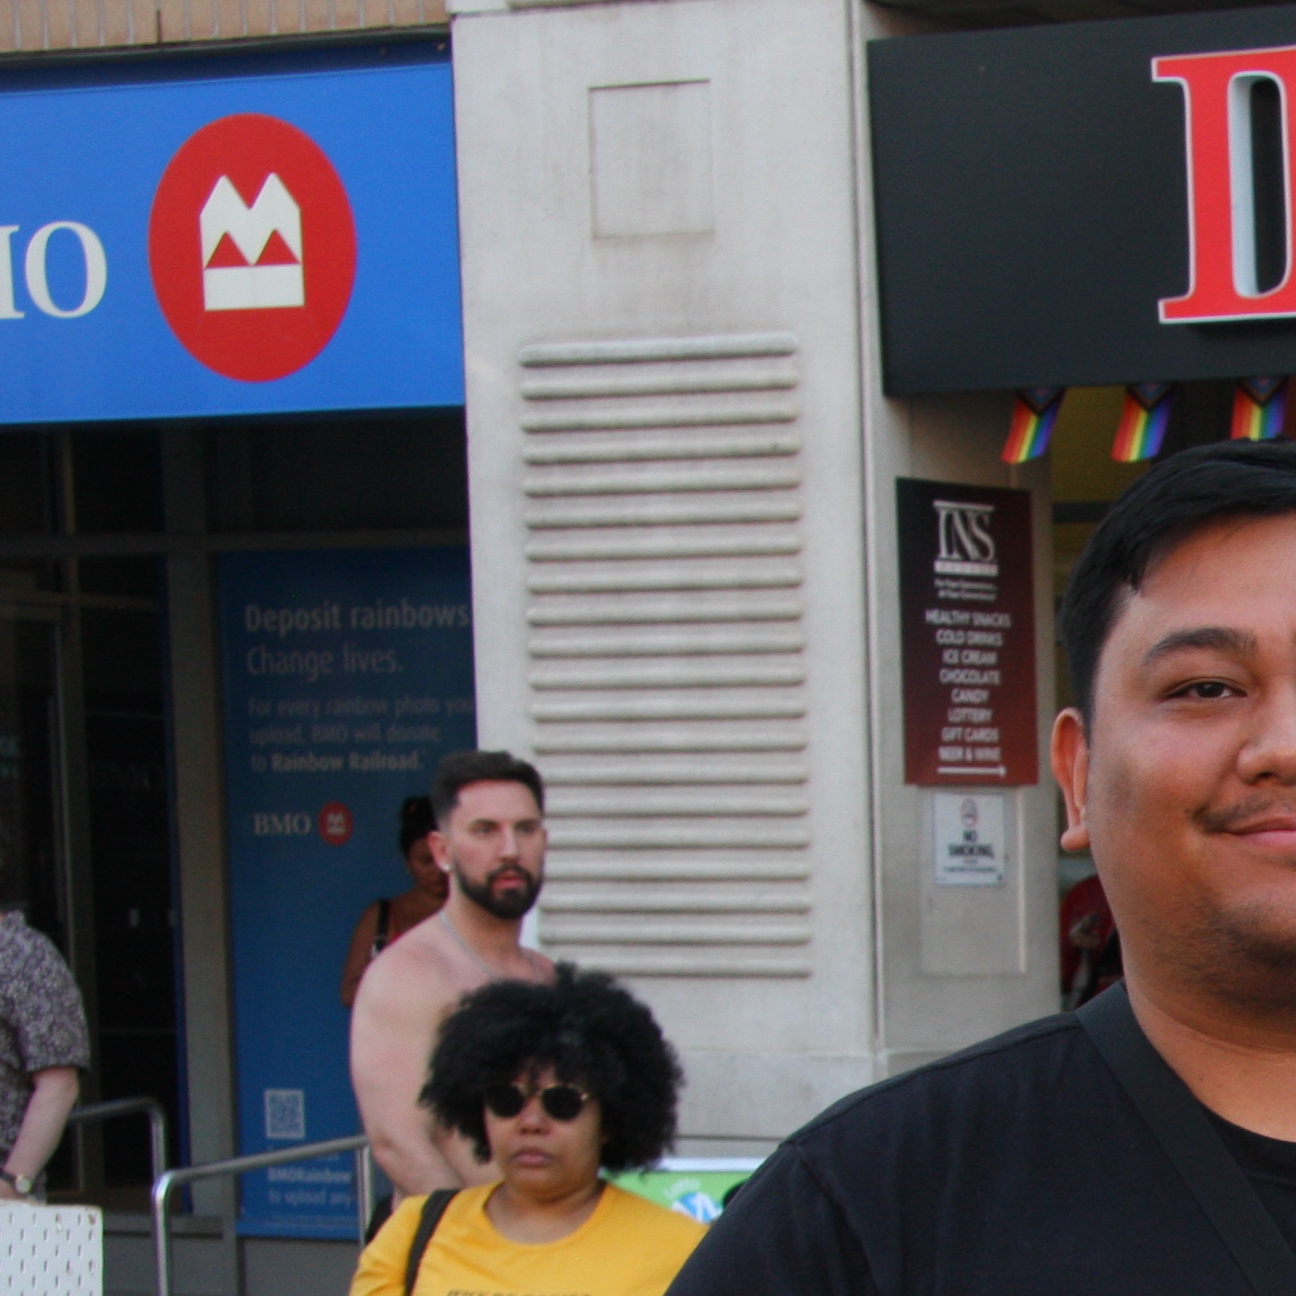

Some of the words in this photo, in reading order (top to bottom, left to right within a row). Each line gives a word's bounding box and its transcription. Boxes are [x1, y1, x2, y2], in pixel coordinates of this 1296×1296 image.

[933, 500, 996, 561] INS
[245, 601, 341, 639] Deposit
[350, 598, 470, 628] rainbows
[247, 643, 334, 682] Change
[254, 813, 312, 836] BMO
